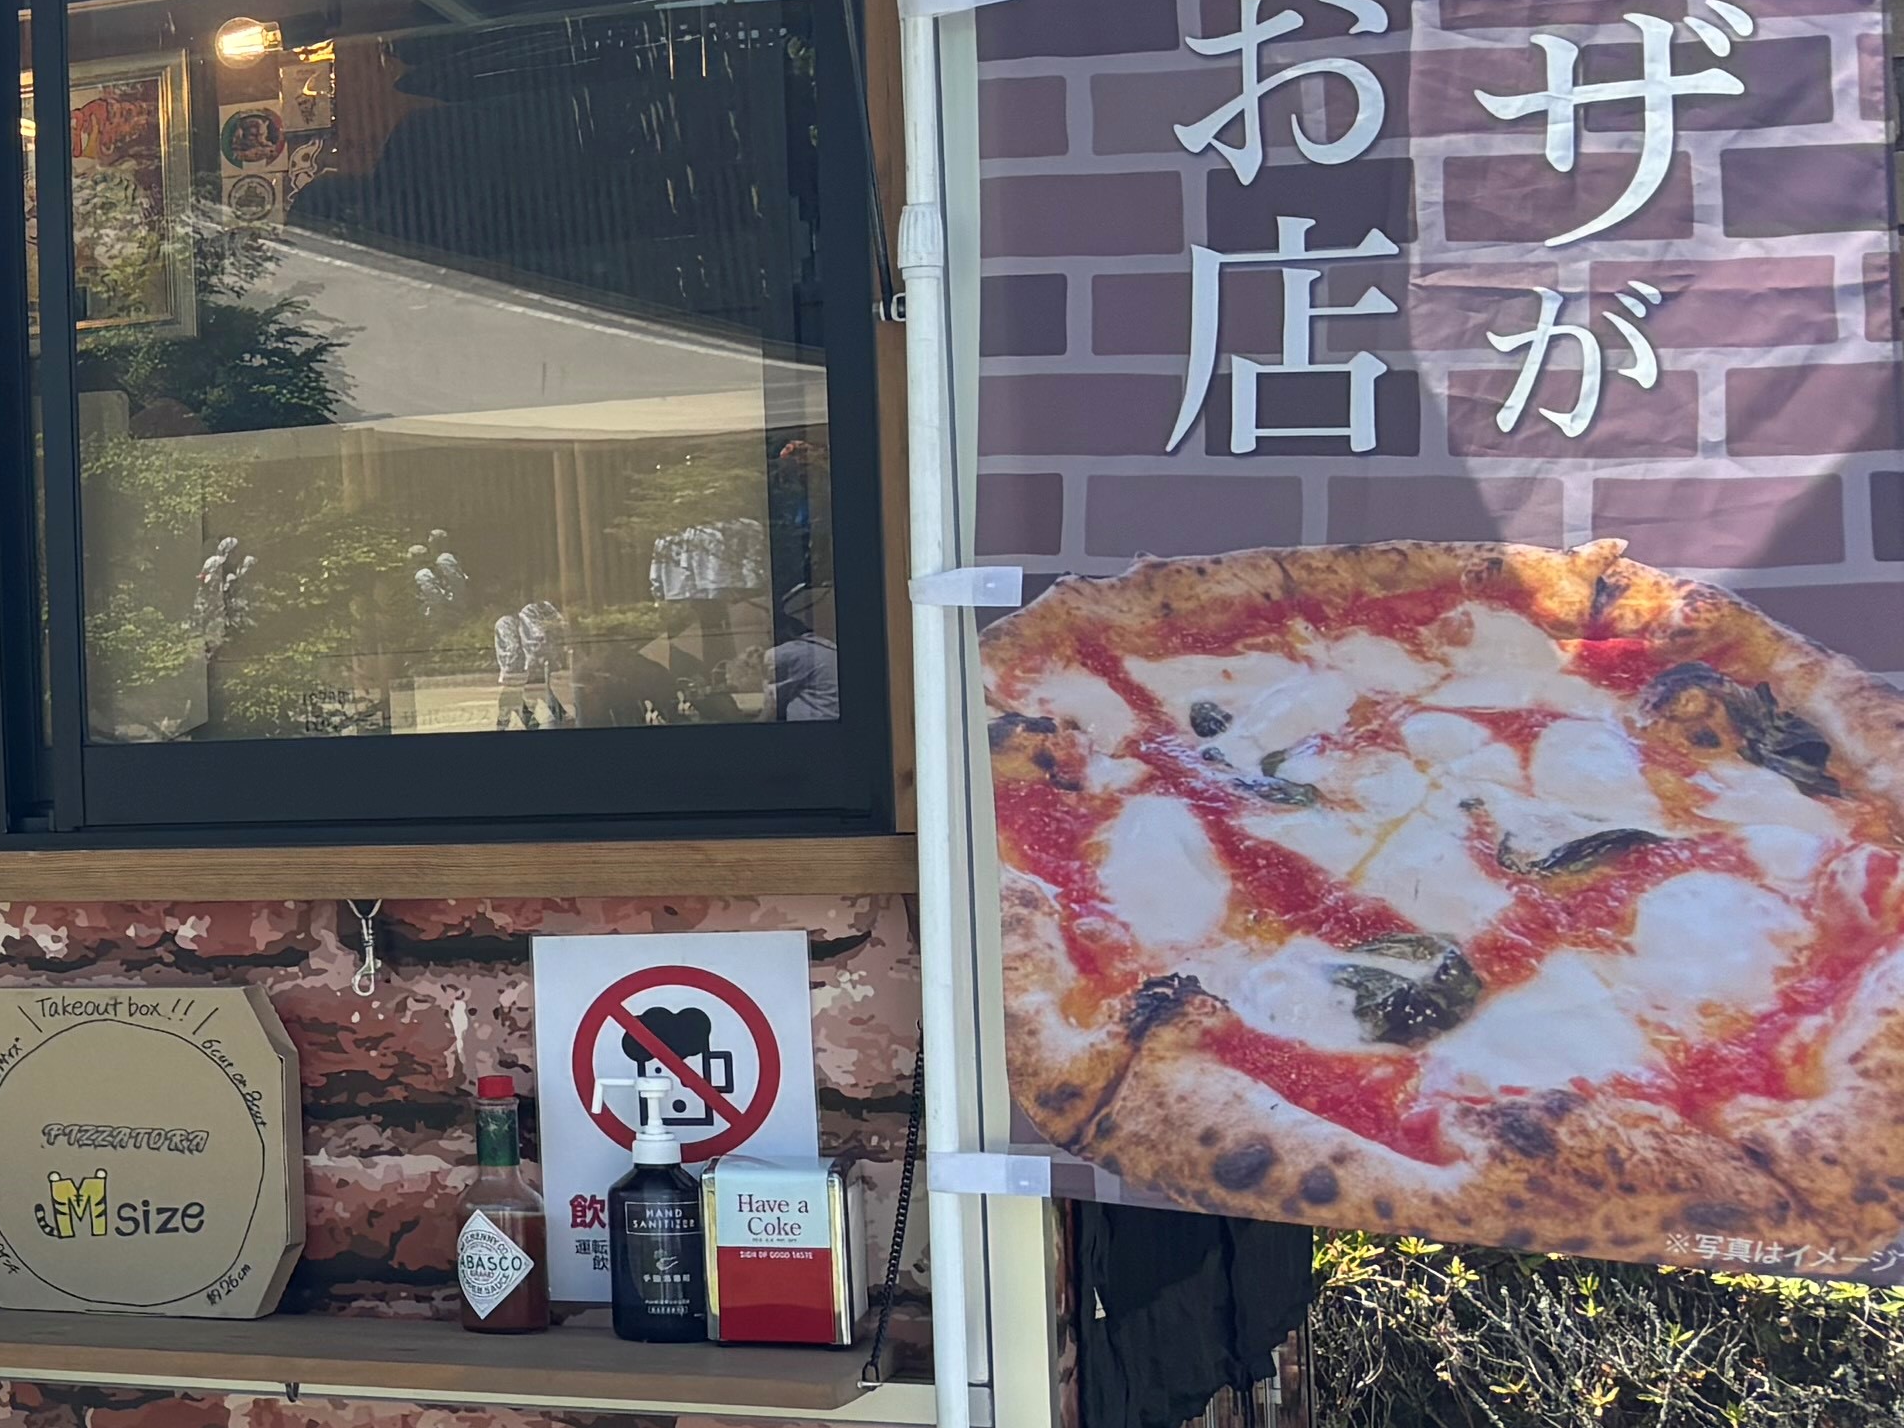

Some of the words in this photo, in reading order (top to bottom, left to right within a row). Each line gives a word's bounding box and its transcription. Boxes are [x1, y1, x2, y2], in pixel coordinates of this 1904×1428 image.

[34, 996, 123, 1019] Takeout
[128, 996, 161, 1018] box
[41, 1123, 210, 1154] PIZZATORA
[47, 1168, 108, 1239] M
[114, 1199, 206, 1237] size
[645, 1208, 683, 1219] HAND
[737, 1193, 790, 1214] Have
[798, 1199, 809, 1214] a
[632, 1219, 695, 1229] SANITIZER
[747, 1216, 802, 1237] Coke
[459, 1255, 523, 1271] ABASCO
